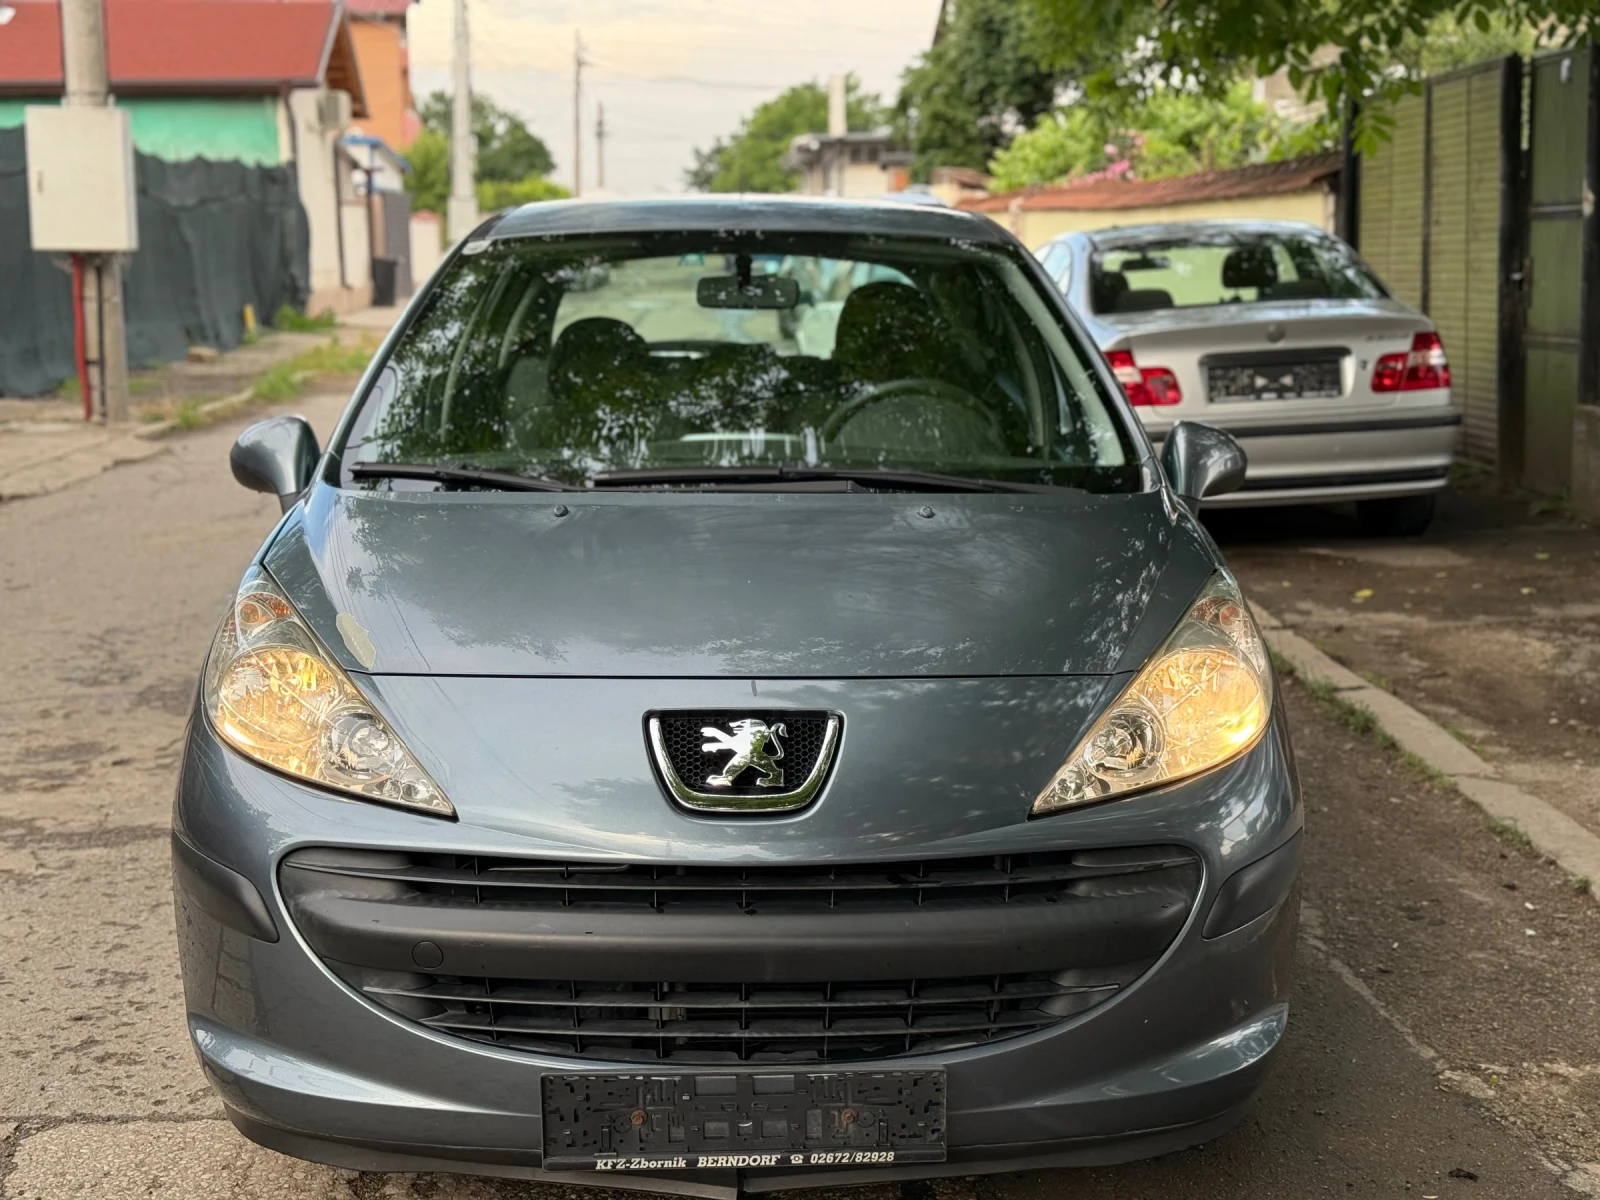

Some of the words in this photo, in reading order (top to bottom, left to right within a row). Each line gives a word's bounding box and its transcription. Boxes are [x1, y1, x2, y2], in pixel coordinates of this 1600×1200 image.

[595, 1157, 687, 1170] KFZ-Zbornik
[697, 1154, 781, 1168] BERNDORF
[810, 1151, 895, 1164] 02672/82928
